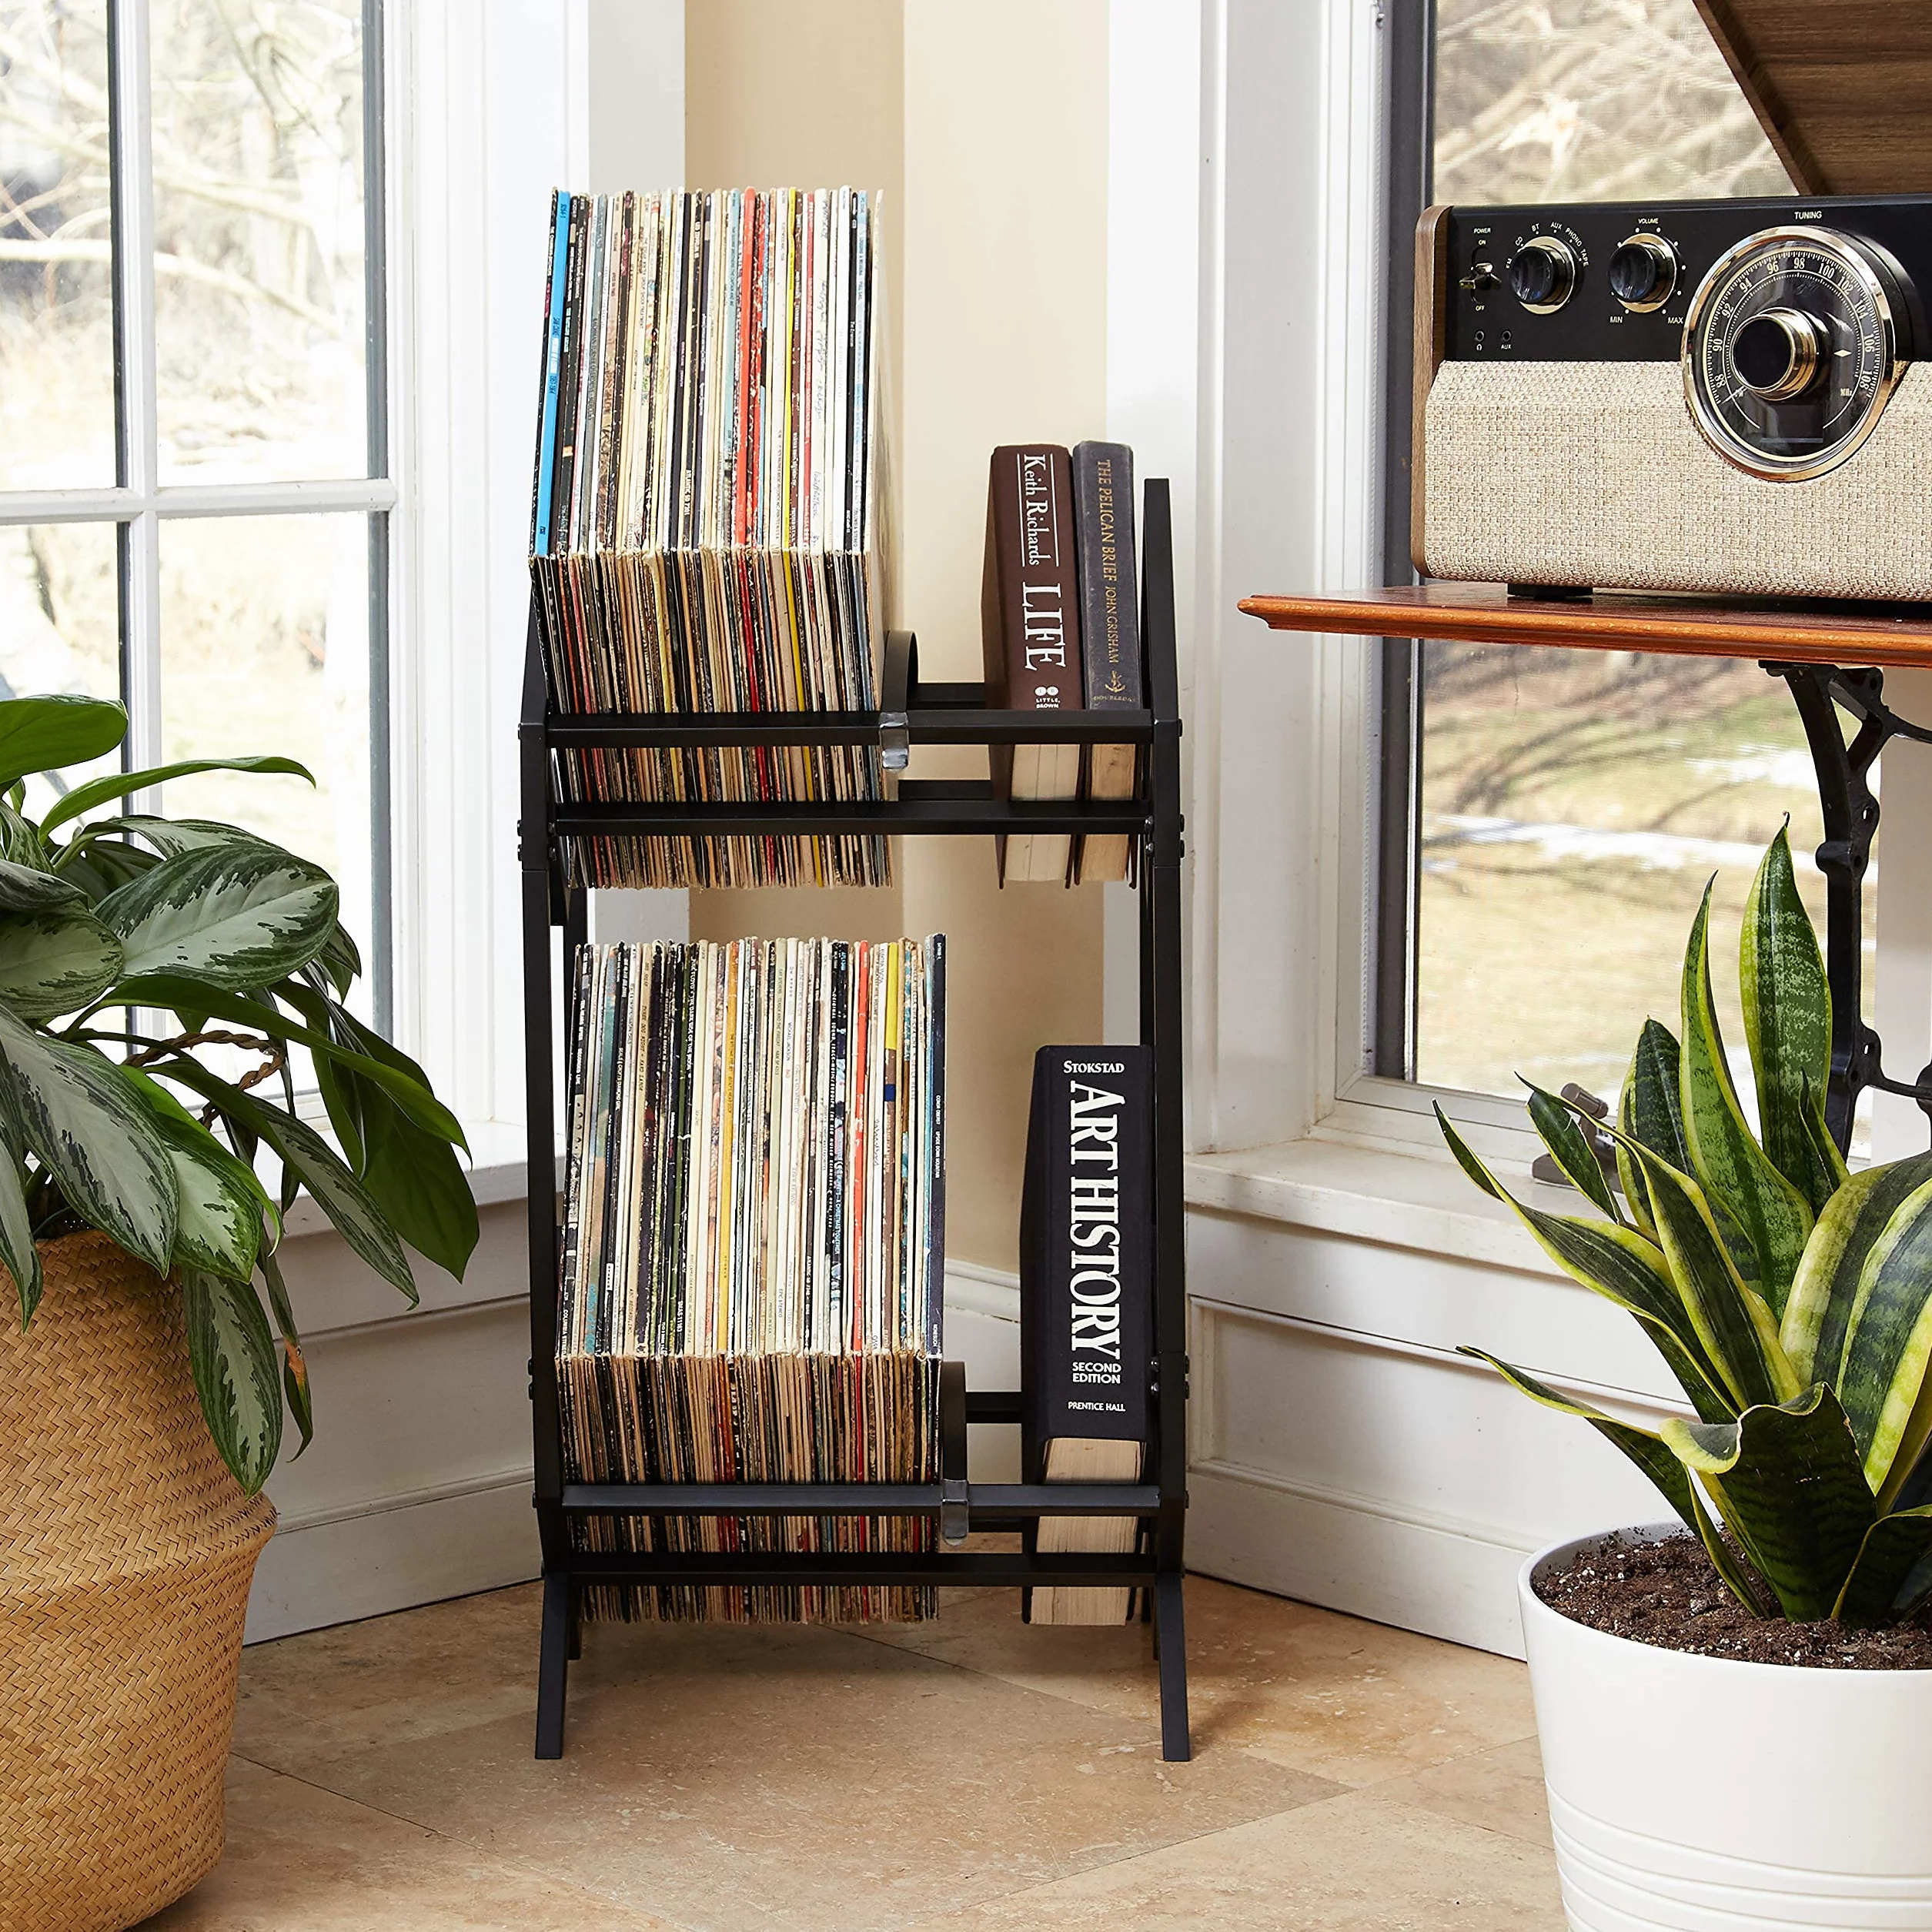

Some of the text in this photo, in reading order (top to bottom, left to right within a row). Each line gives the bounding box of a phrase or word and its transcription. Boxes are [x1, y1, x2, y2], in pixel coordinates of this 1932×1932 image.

[1794, 211, 1822, 219] TUNING
[1532, 223, 1539, 232] BT
[1551, 221, 1563, 230] AUX
[1566, 227, 1583, 247] PHONO
[1580, 249, 1589, 267] TAPE
[1793, 257, 1805, 269] 98
[1767, 261, 1779, 275] 96
[1818, 263, 1835, 279] 100
[1740, 278, 1753, 292] 94
[1837, 276, 1854, 295] 102
[1721, 303, 1734, 319] 92
[1854, 300, 1867, 319] 104
[1712, 338, 1723, 352] 90
[1863, 333, 1875, 353] 106
[1714, 374, 1726, 388] 88
[1860, 370, 1873, 389] 108
[1024, 454, 1051, 566] Keith Richards
[1098, 460, 1117, 582] THE PELICAN BRIEF
[1022, 581, 1066, 671] LIFE
[1105, 586, 1118, 663] JOHN GRISHAM
[1063, 1060, 1125, 1074] STOKSTAD
[1069, 1080, 1125, 1360] ART HISTORY
[1072, 1362, 1121, 1373] SECOND
[1072, 1372, 1121, 1384] EDITION
[1068, 1402, 1125, 1412] PRENTICE HALL
